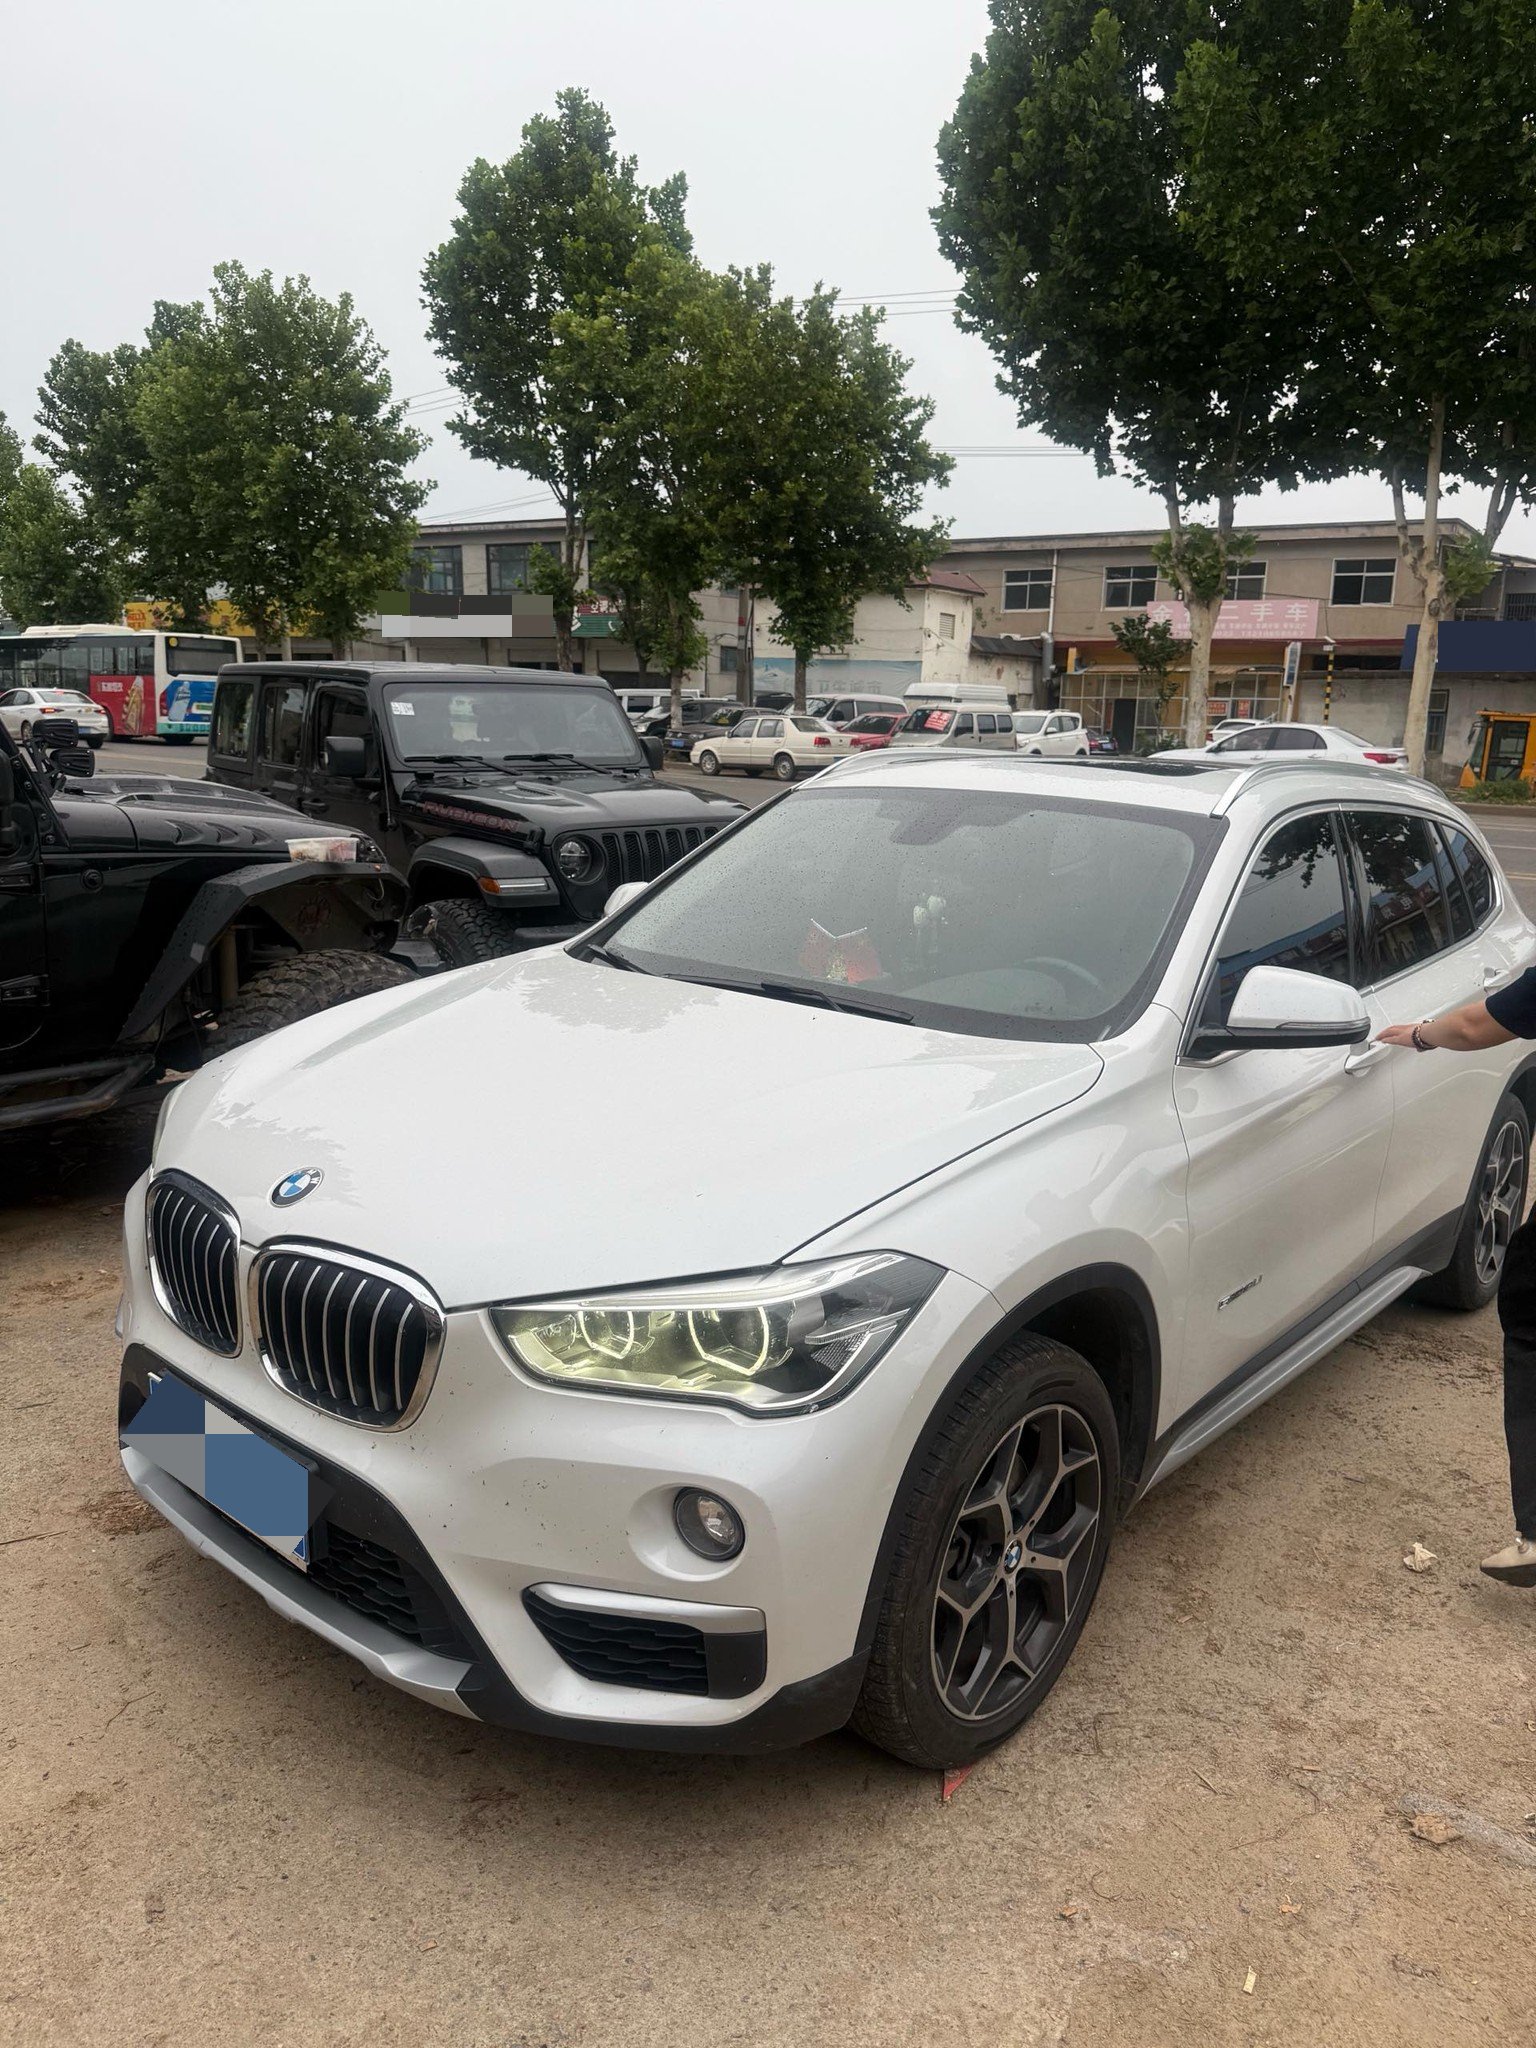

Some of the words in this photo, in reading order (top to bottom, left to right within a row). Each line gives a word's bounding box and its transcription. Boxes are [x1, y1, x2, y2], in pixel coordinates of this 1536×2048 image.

[1151, 603, 1309, 623] 金二手车
[423, 801, 519, 832] RUBICON
